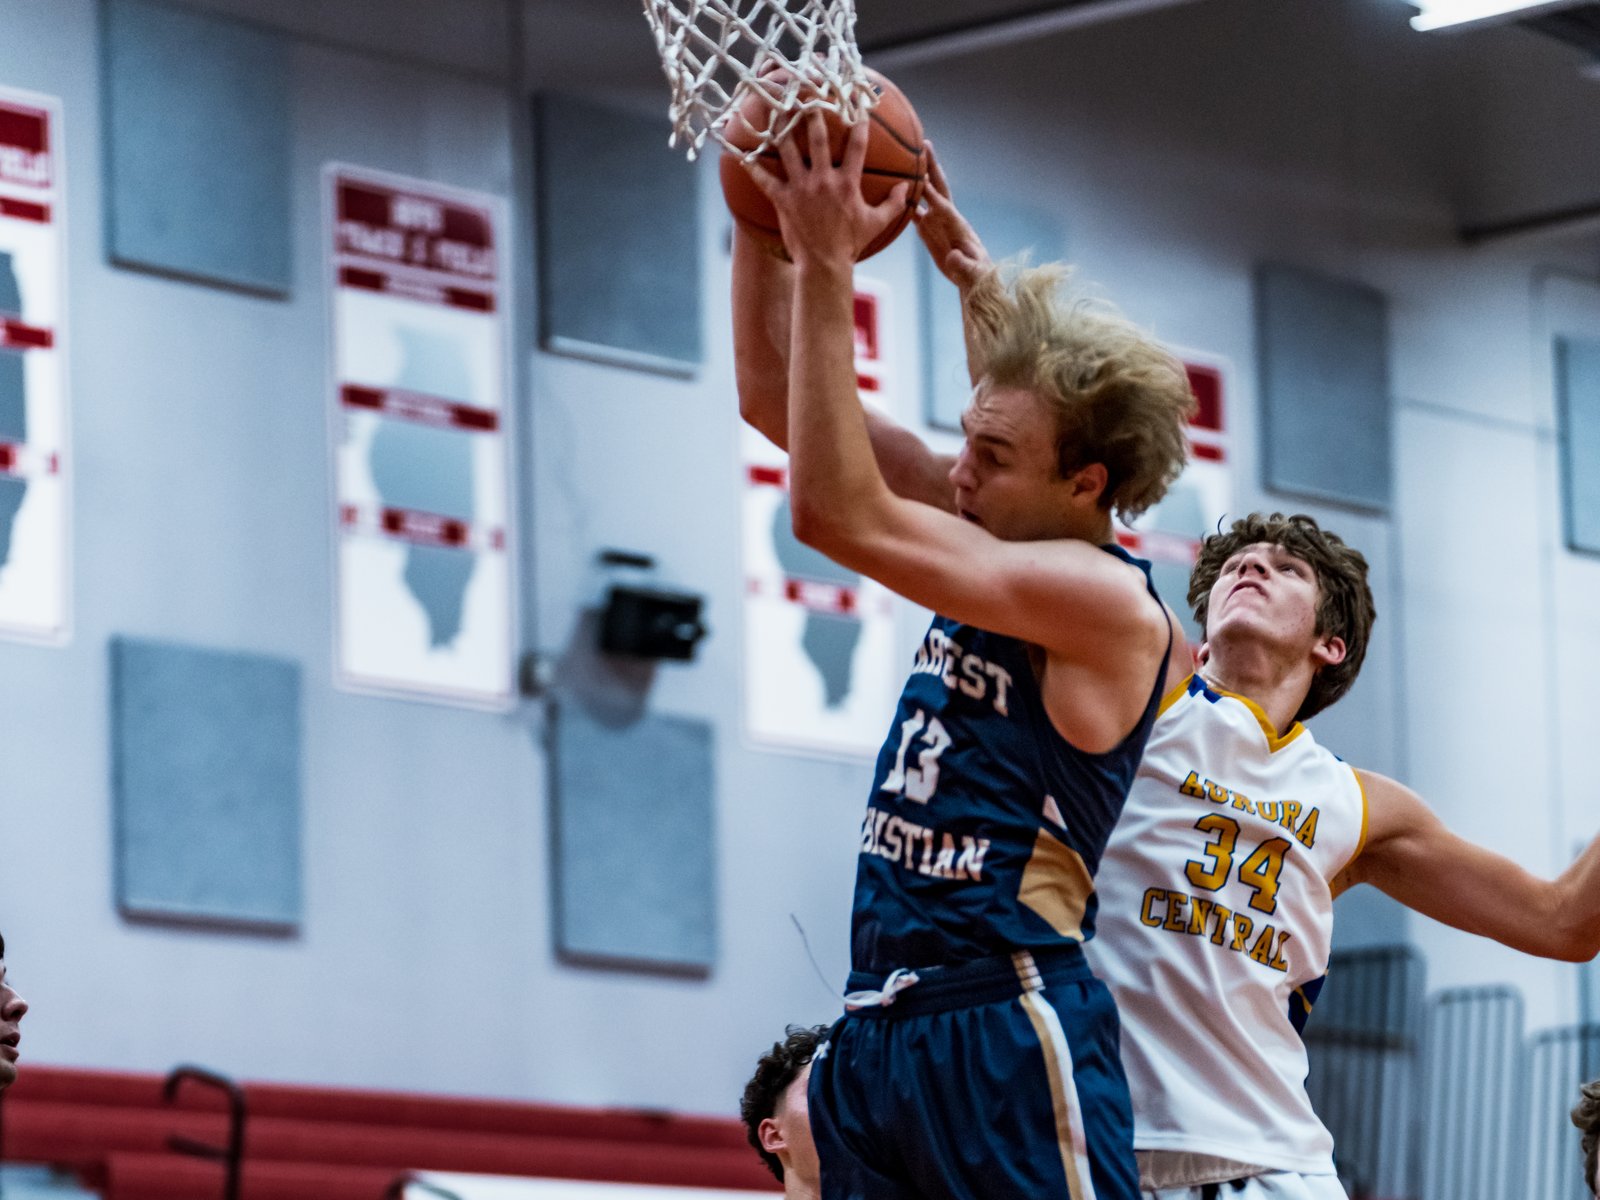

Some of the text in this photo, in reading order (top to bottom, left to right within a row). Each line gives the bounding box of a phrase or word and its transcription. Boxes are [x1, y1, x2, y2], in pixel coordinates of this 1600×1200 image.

[881, 708, 951, 805] 13
[1179, 770, 1320, 849] AURORA
[1184, 813, 1293, 915] 34
[1140, 887, 1291, 972] CENTRAL
